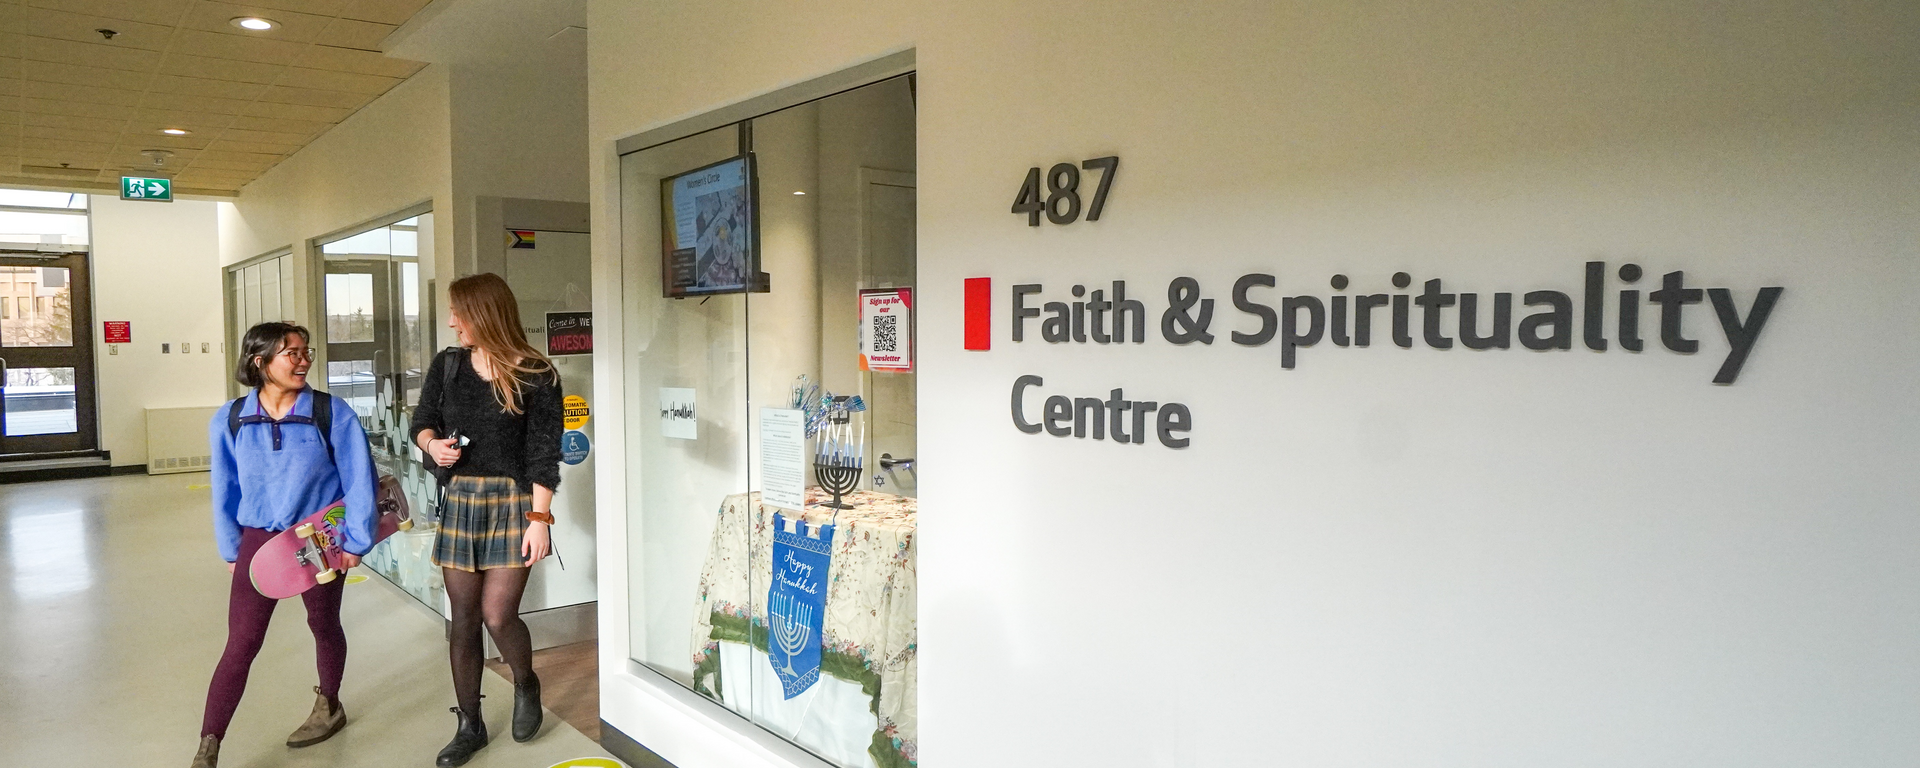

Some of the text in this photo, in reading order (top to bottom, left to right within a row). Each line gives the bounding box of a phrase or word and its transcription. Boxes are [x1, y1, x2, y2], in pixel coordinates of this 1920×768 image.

[1011, 155, 1120, 228] 487
[869, 298, 882, 306] Sign
[883, 298, 890, 306] up
[525, 326, 545, 334] ituali
[549, 319, 567, 329] Come
[568, 316, 576, 325] in
[1011, 260, 1786, 387] Faith & Spirituality
[550, 334, 593, 351] AWESOM
[1010, 374, 1193, 450] Centre
[784, 549, 814, 578] Happy
[776, 568, 818, 595] Hanukkah
